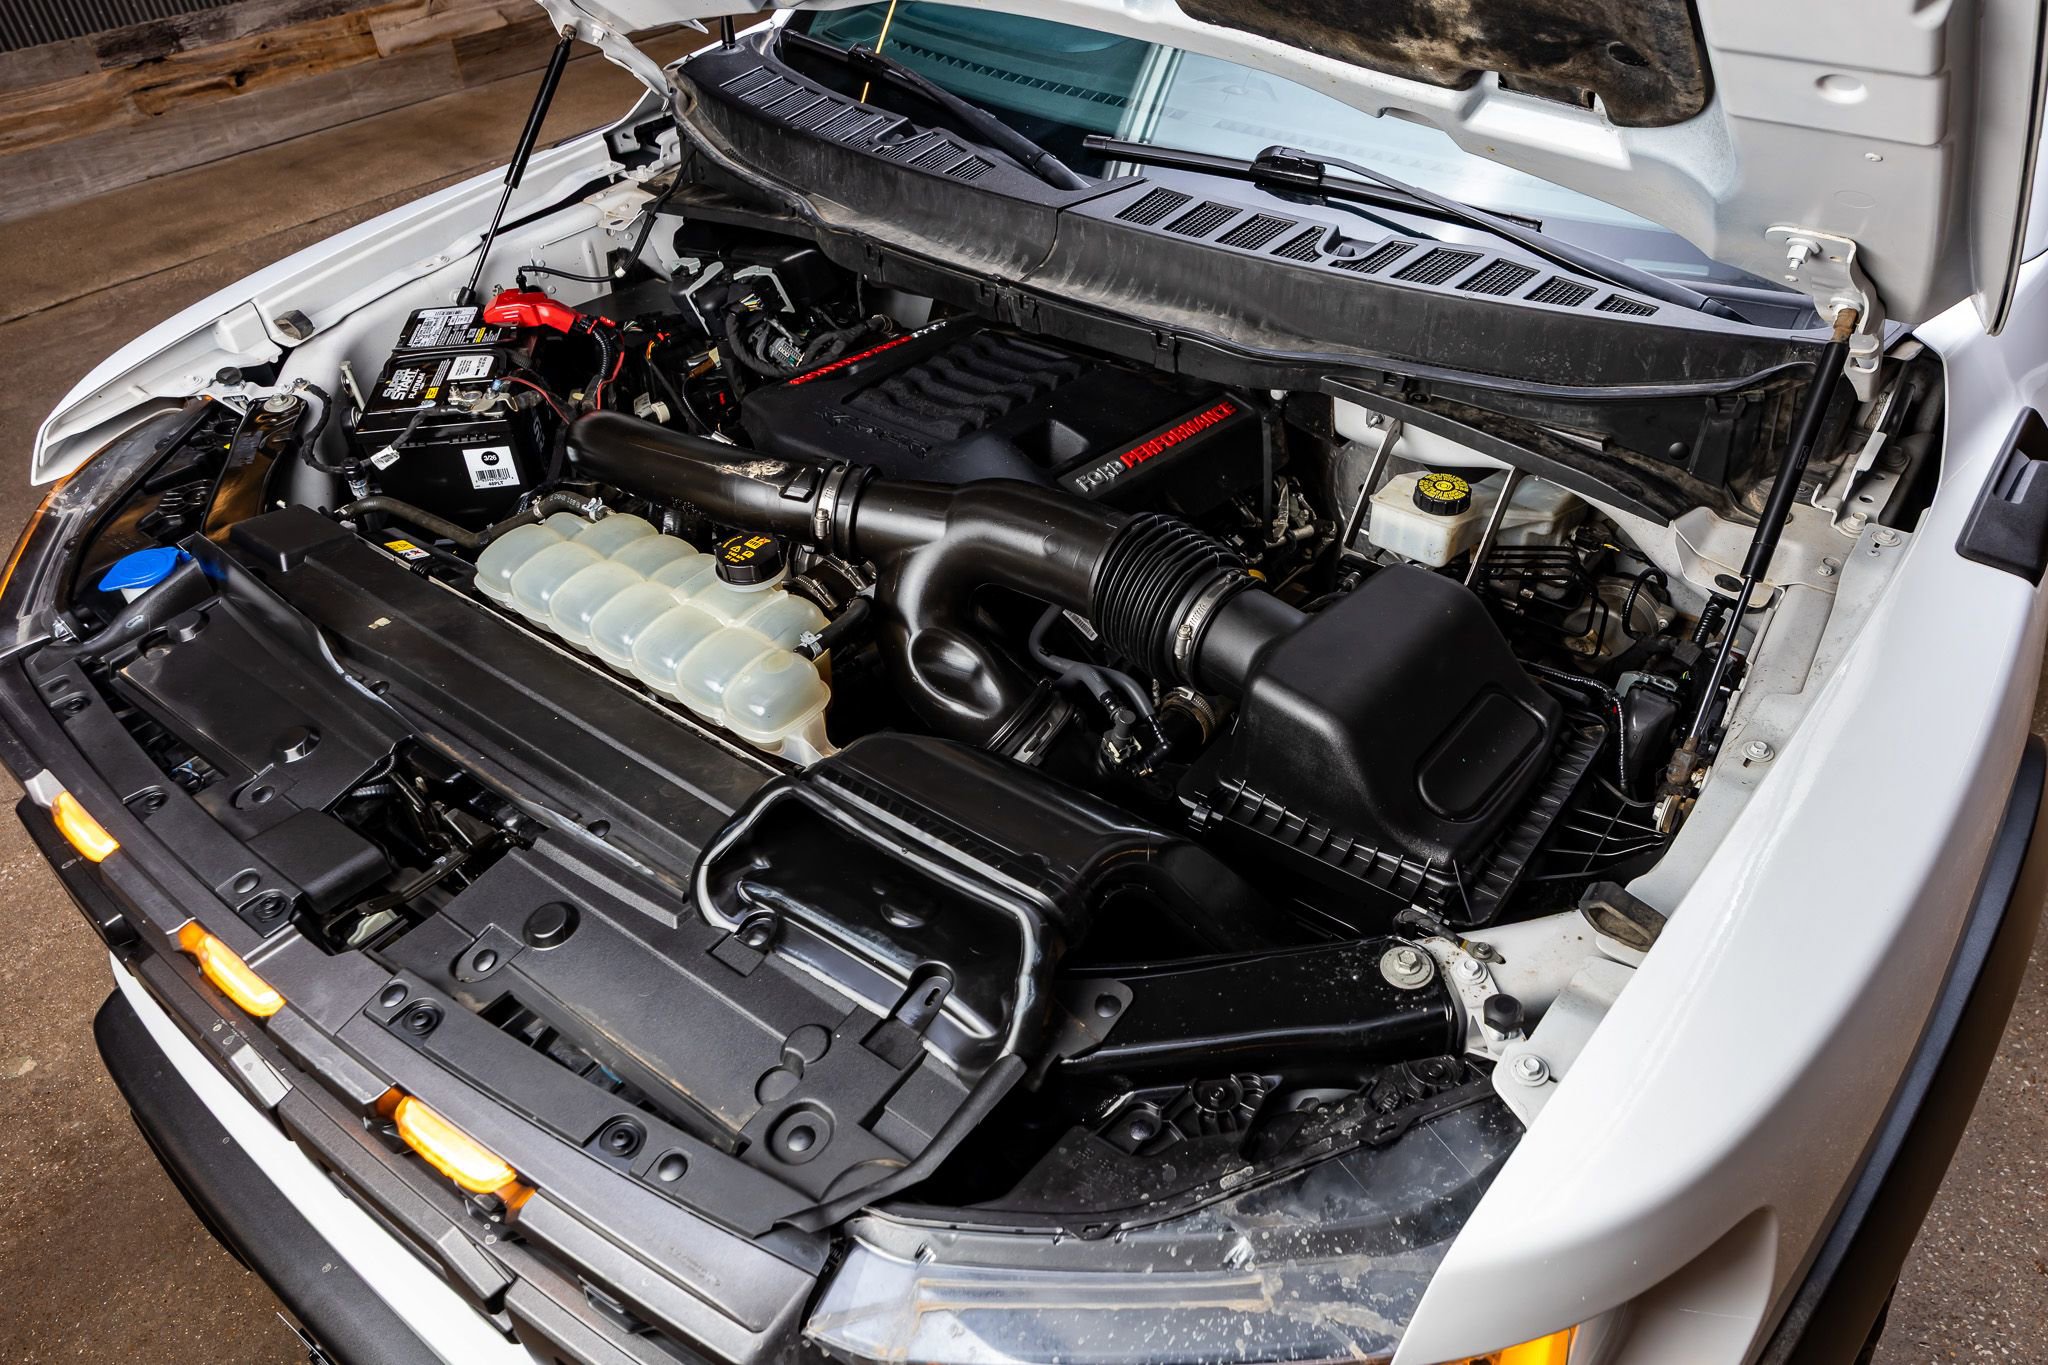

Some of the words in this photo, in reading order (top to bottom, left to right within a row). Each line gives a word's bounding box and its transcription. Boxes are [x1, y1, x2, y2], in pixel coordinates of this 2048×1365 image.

[382, 369, 405, 397] SUPER
[391, 369, 417, 399] START
[407, 373, 425, 398] PLATINUM
[1075, 460, 1127, 492] FORD
[1119, 401, 1238, 469] PERFORMANCE
